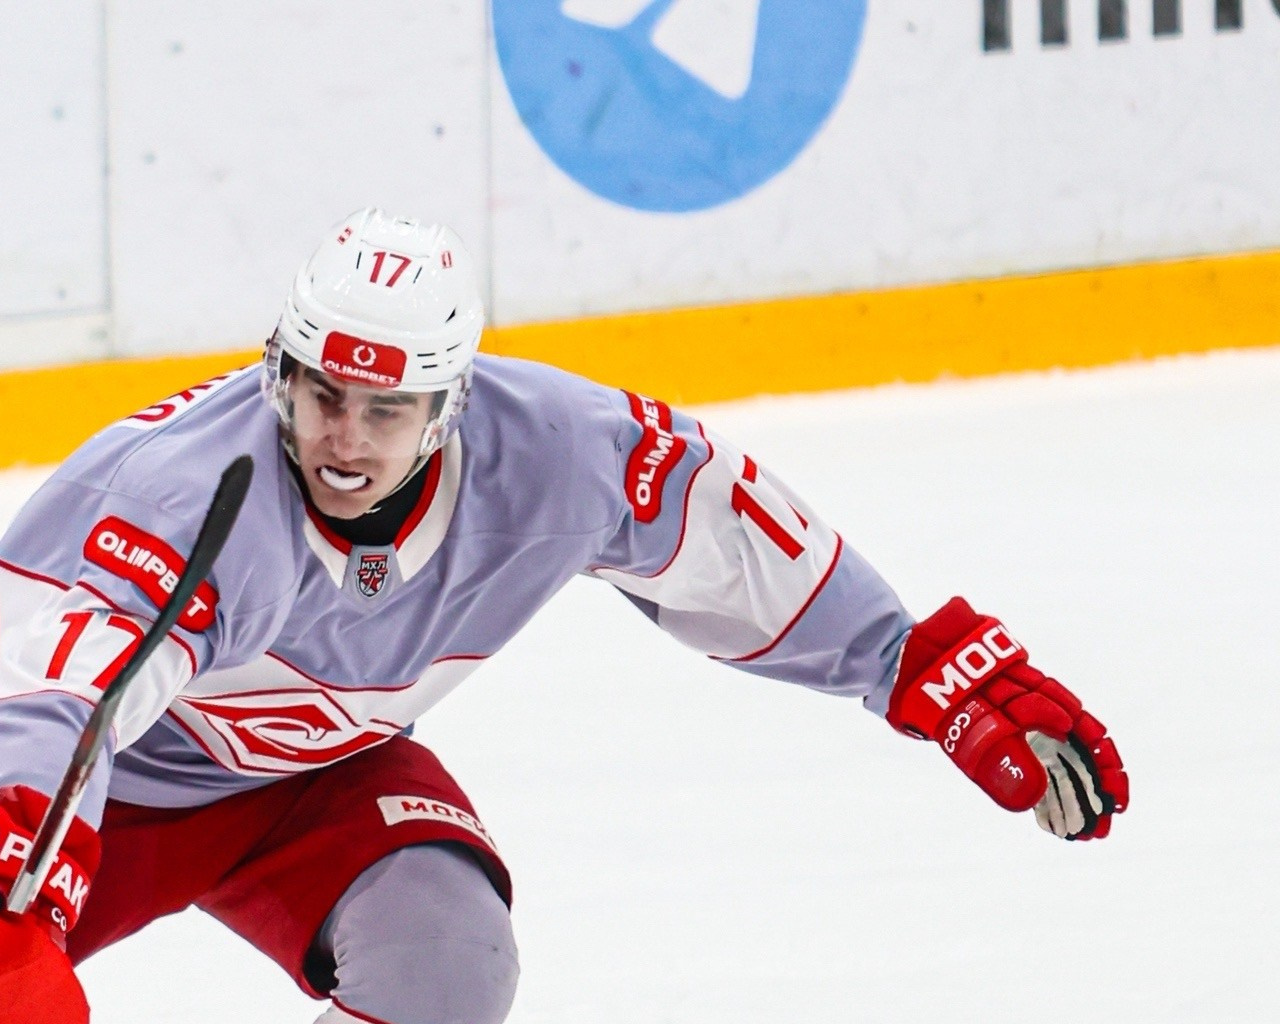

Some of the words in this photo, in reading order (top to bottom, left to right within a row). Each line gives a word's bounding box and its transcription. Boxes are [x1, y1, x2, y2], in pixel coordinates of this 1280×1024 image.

[369, 251, 412, 288] 17
[324, 359, 398, 386] OLIMPBET
[96, 530, 209, 618] OLIMPBT
[44, 611, 146, 692] 17
[920, 624, 1022, 711] МОС
